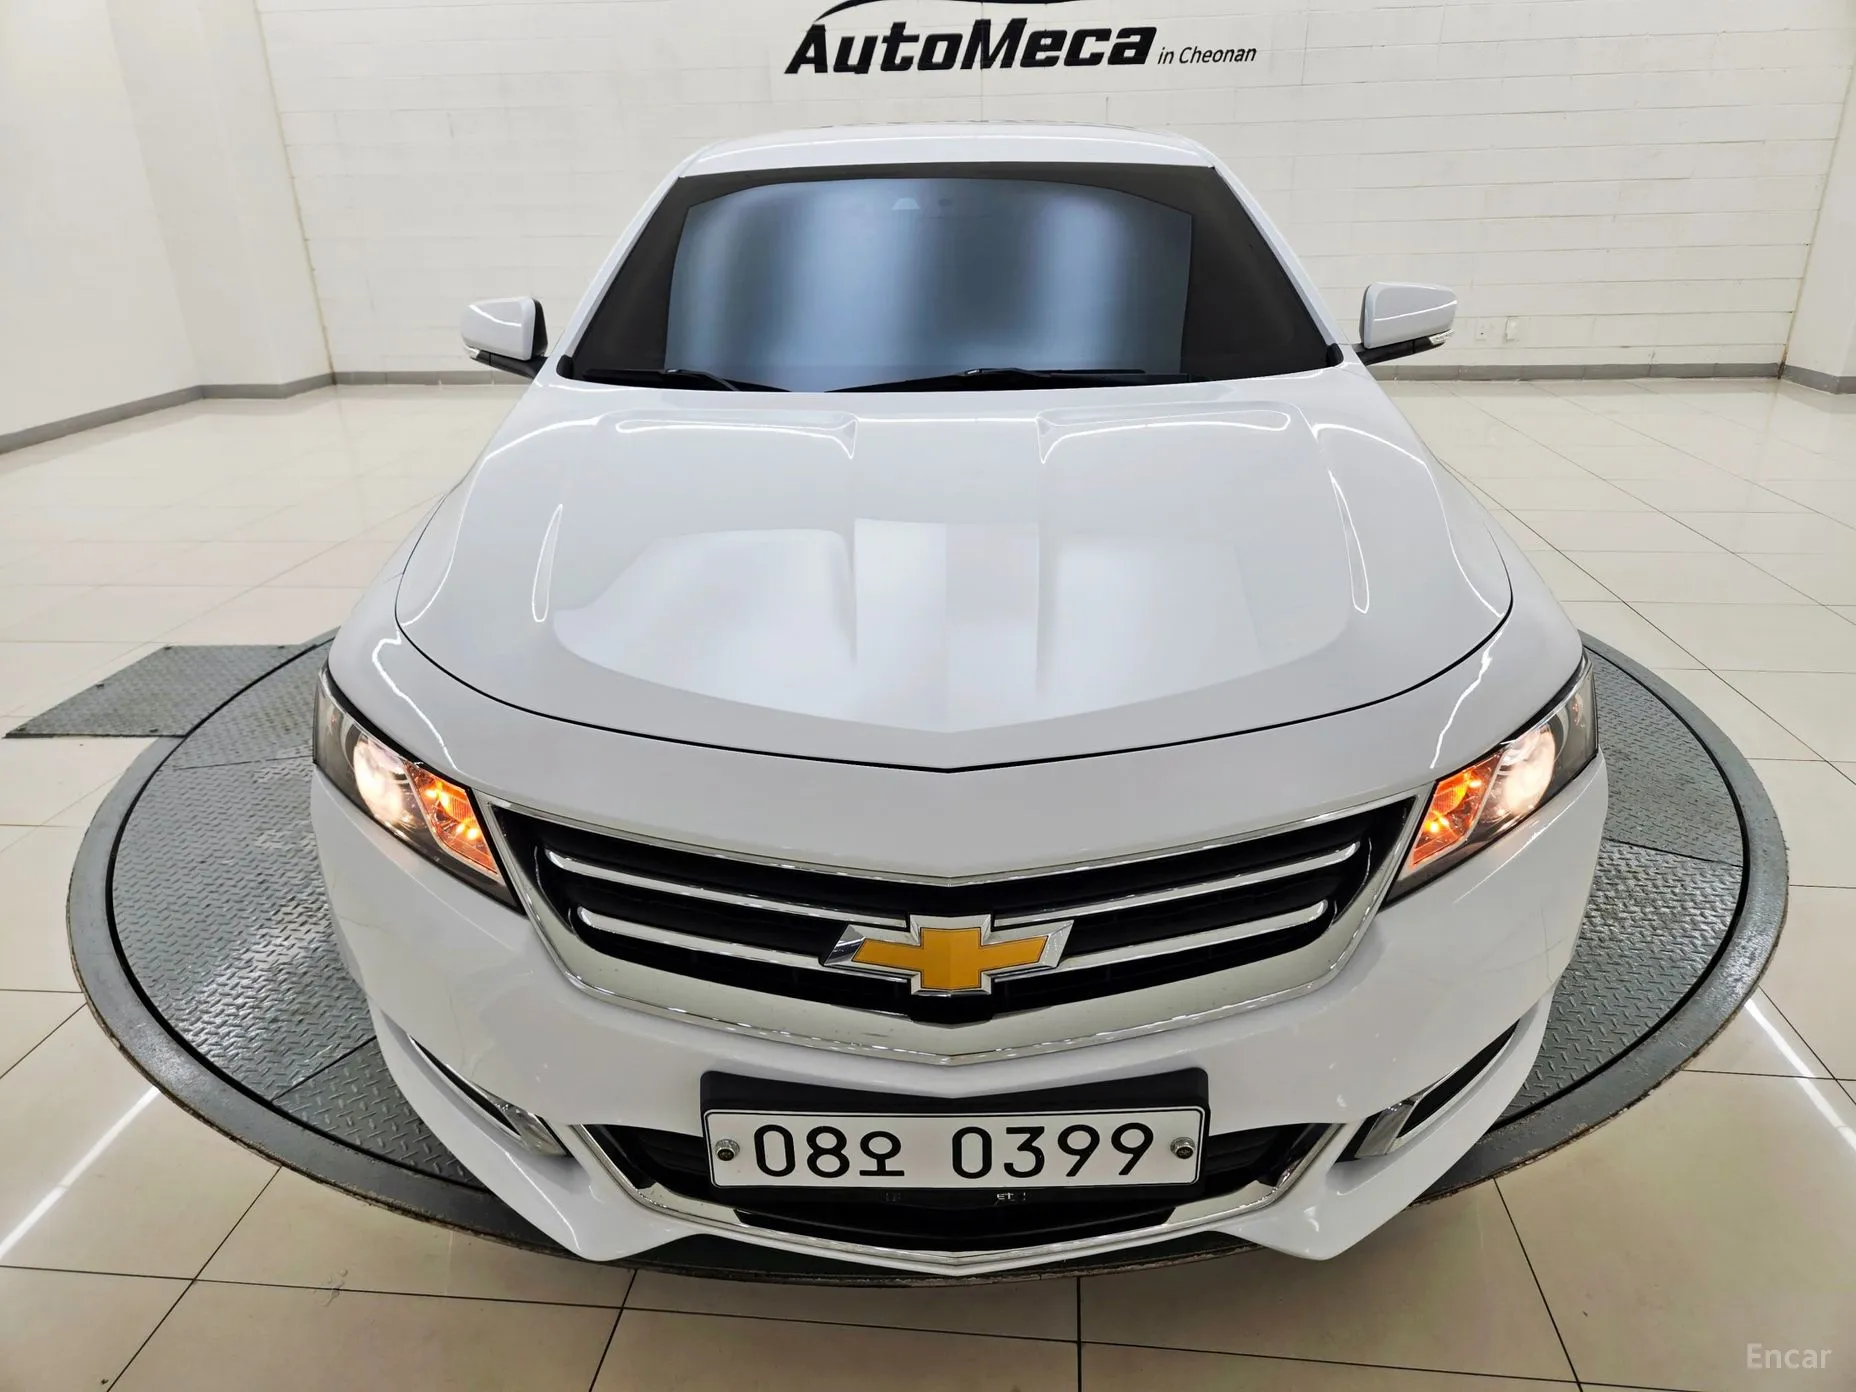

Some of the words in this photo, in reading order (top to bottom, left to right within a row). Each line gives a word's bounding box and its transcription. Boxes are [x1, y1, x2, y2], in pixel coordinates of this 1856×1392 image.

[784, 17, 1157, 75] AutoMeca
[1157, 46, 1175, 65] in
[1178, 45, 1257, 64] Cheonan
[754, 1124, 905, 1178] 08오
[952, 1122, 1154, 1179] 0399
